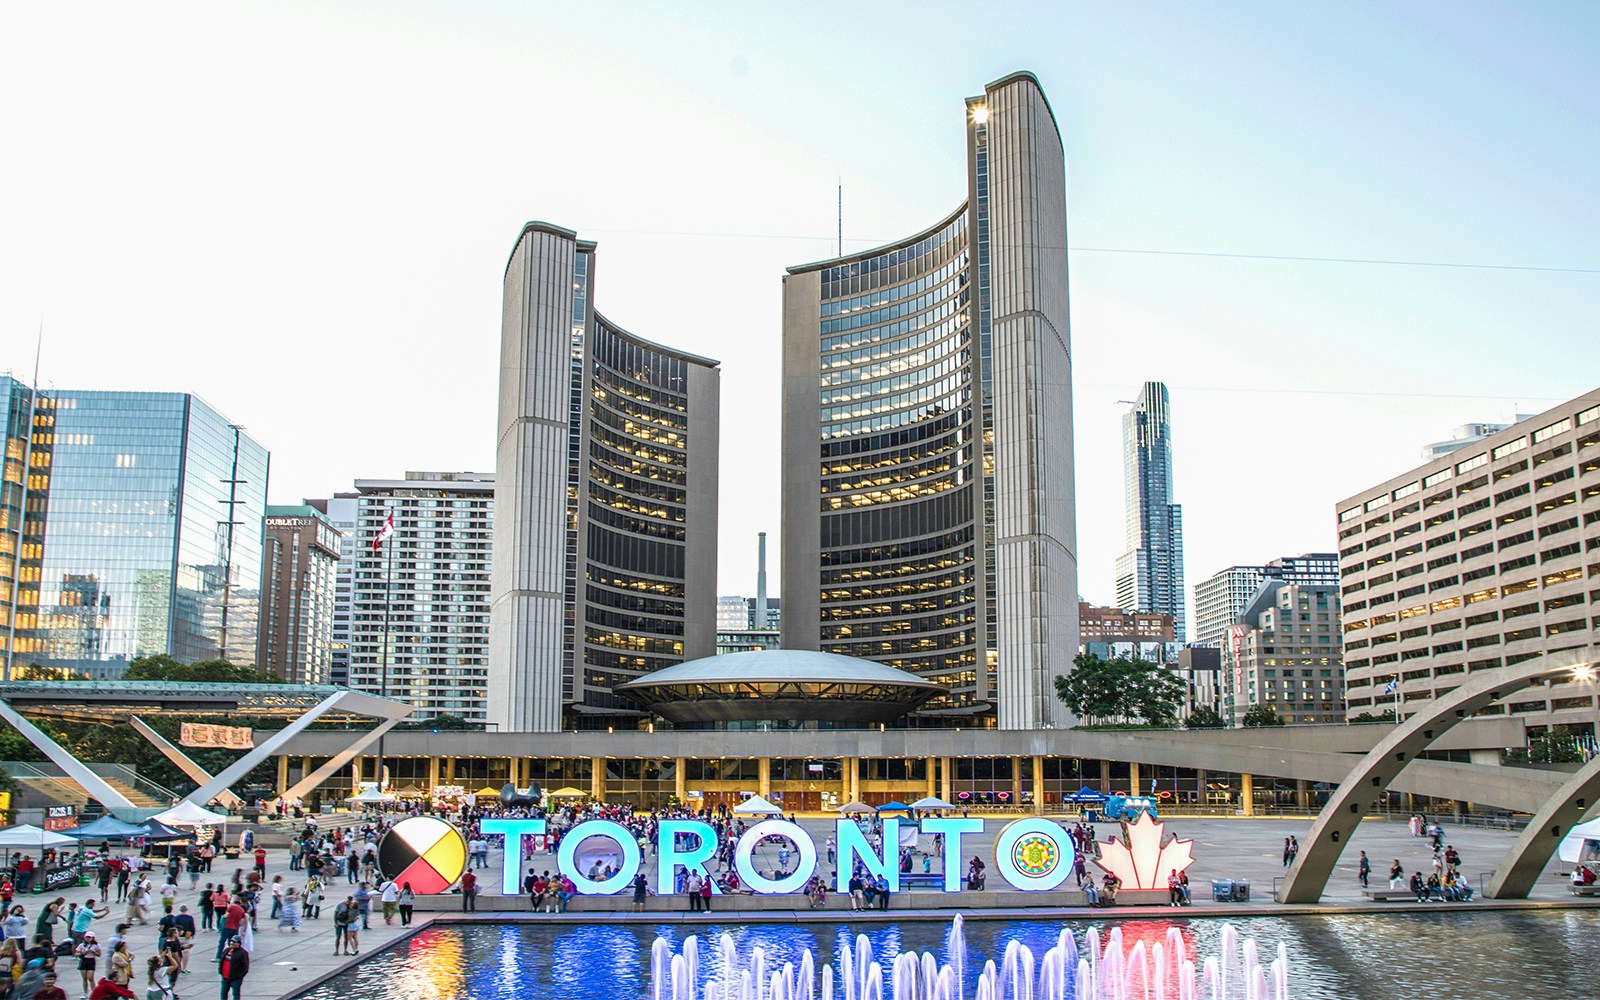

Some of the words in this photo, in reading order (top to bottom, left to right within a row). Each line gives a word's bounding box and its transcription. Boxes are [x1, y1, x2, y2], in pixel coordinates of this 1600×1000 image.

[265, 518, 313, 526] OUBLETREE
[1232, 627, 1244, 694] Marriott
[480, 817, 1076, 895] TORONTO
